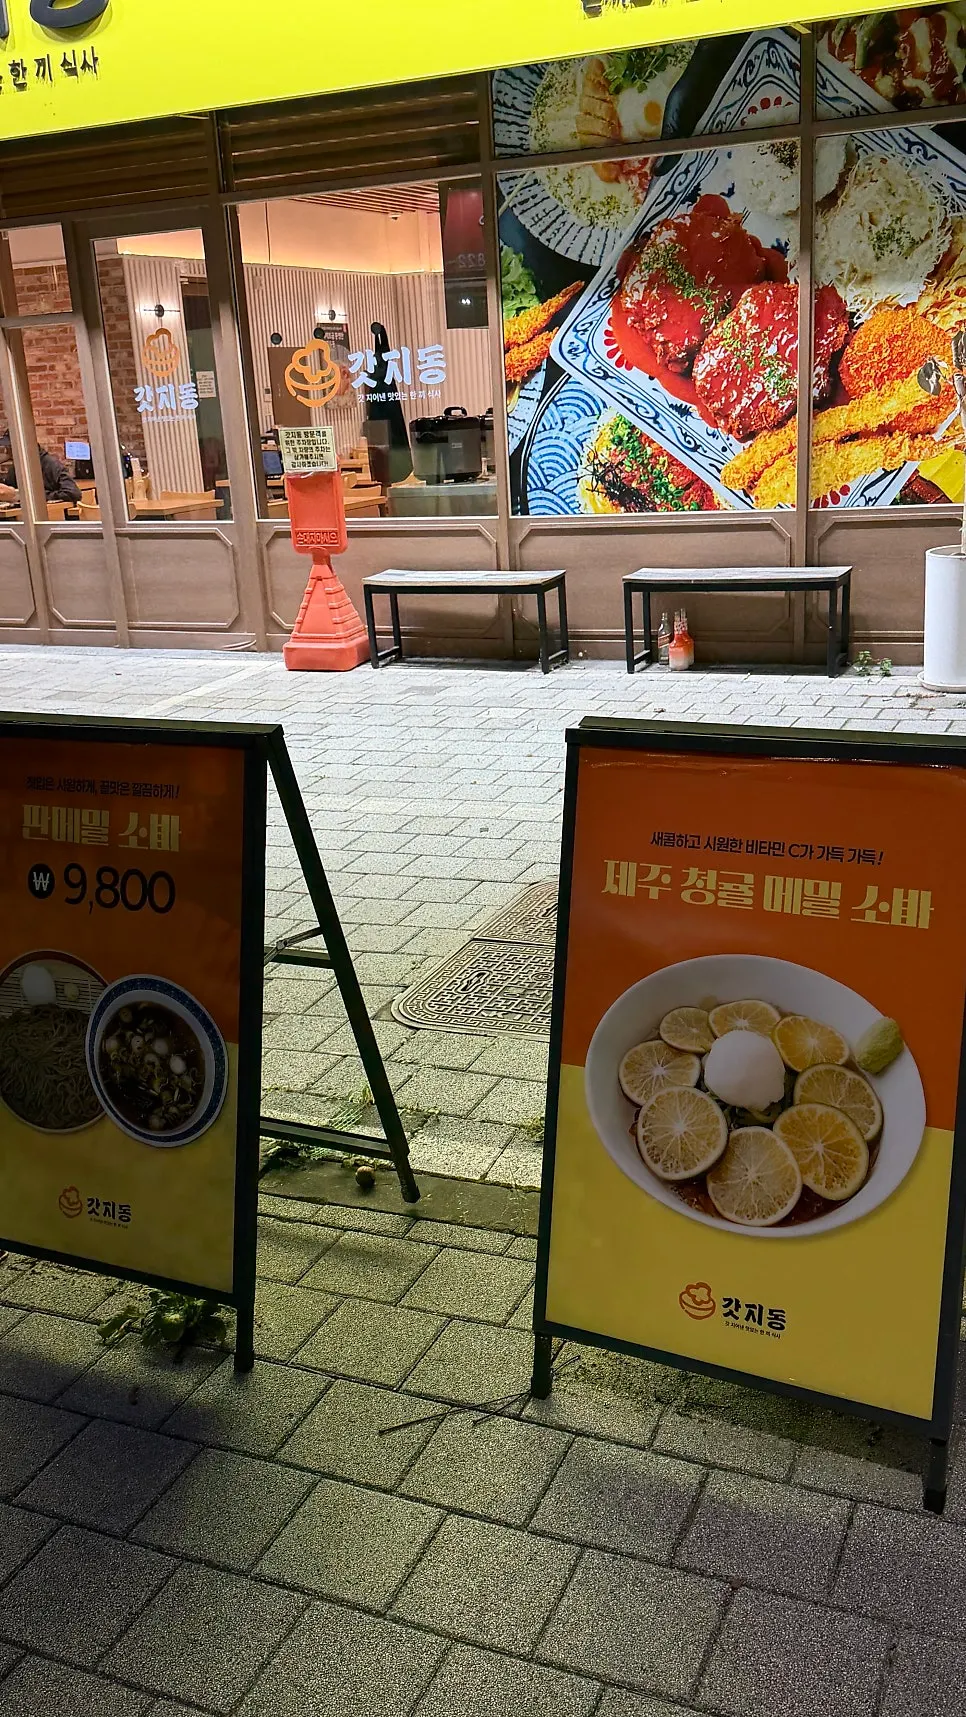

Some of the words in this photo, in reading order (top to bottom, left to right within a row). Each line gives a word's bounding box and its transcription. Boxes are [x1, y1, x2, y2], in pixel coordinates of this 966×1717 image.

[8, 59, 27, 92] 한
[34, 53, 53, 82] 끼
[60, 46, 99, 79] 식사
[347, 343, 447, 389] 갓지동
[133, 382, 199, 413] 갓지동
[22, 804, 110, 846] 판메밀
[118, 812, 182, 852] 소바
[650, 832, 701, 849] 새콤하고
[703, 835, 743, 854] 시원한
[745, 839, 786, 857] 비타민
[788, 843, 815, 860] C가
[816, 845, 845, 863] 가득
[847, 848, 884, 866] 가득!
[63, 862, 176, 915] 9,800
[601, 859, 673, 901] 제주
[680, 867, 755, 910] 청귤
[762, 875, 842, 920] 메밀
[850, 885, 935, 930] 소바
[86, 1197, 132, 1223] 갓지동
[721, 1297, 787, 1331] 갓지동
